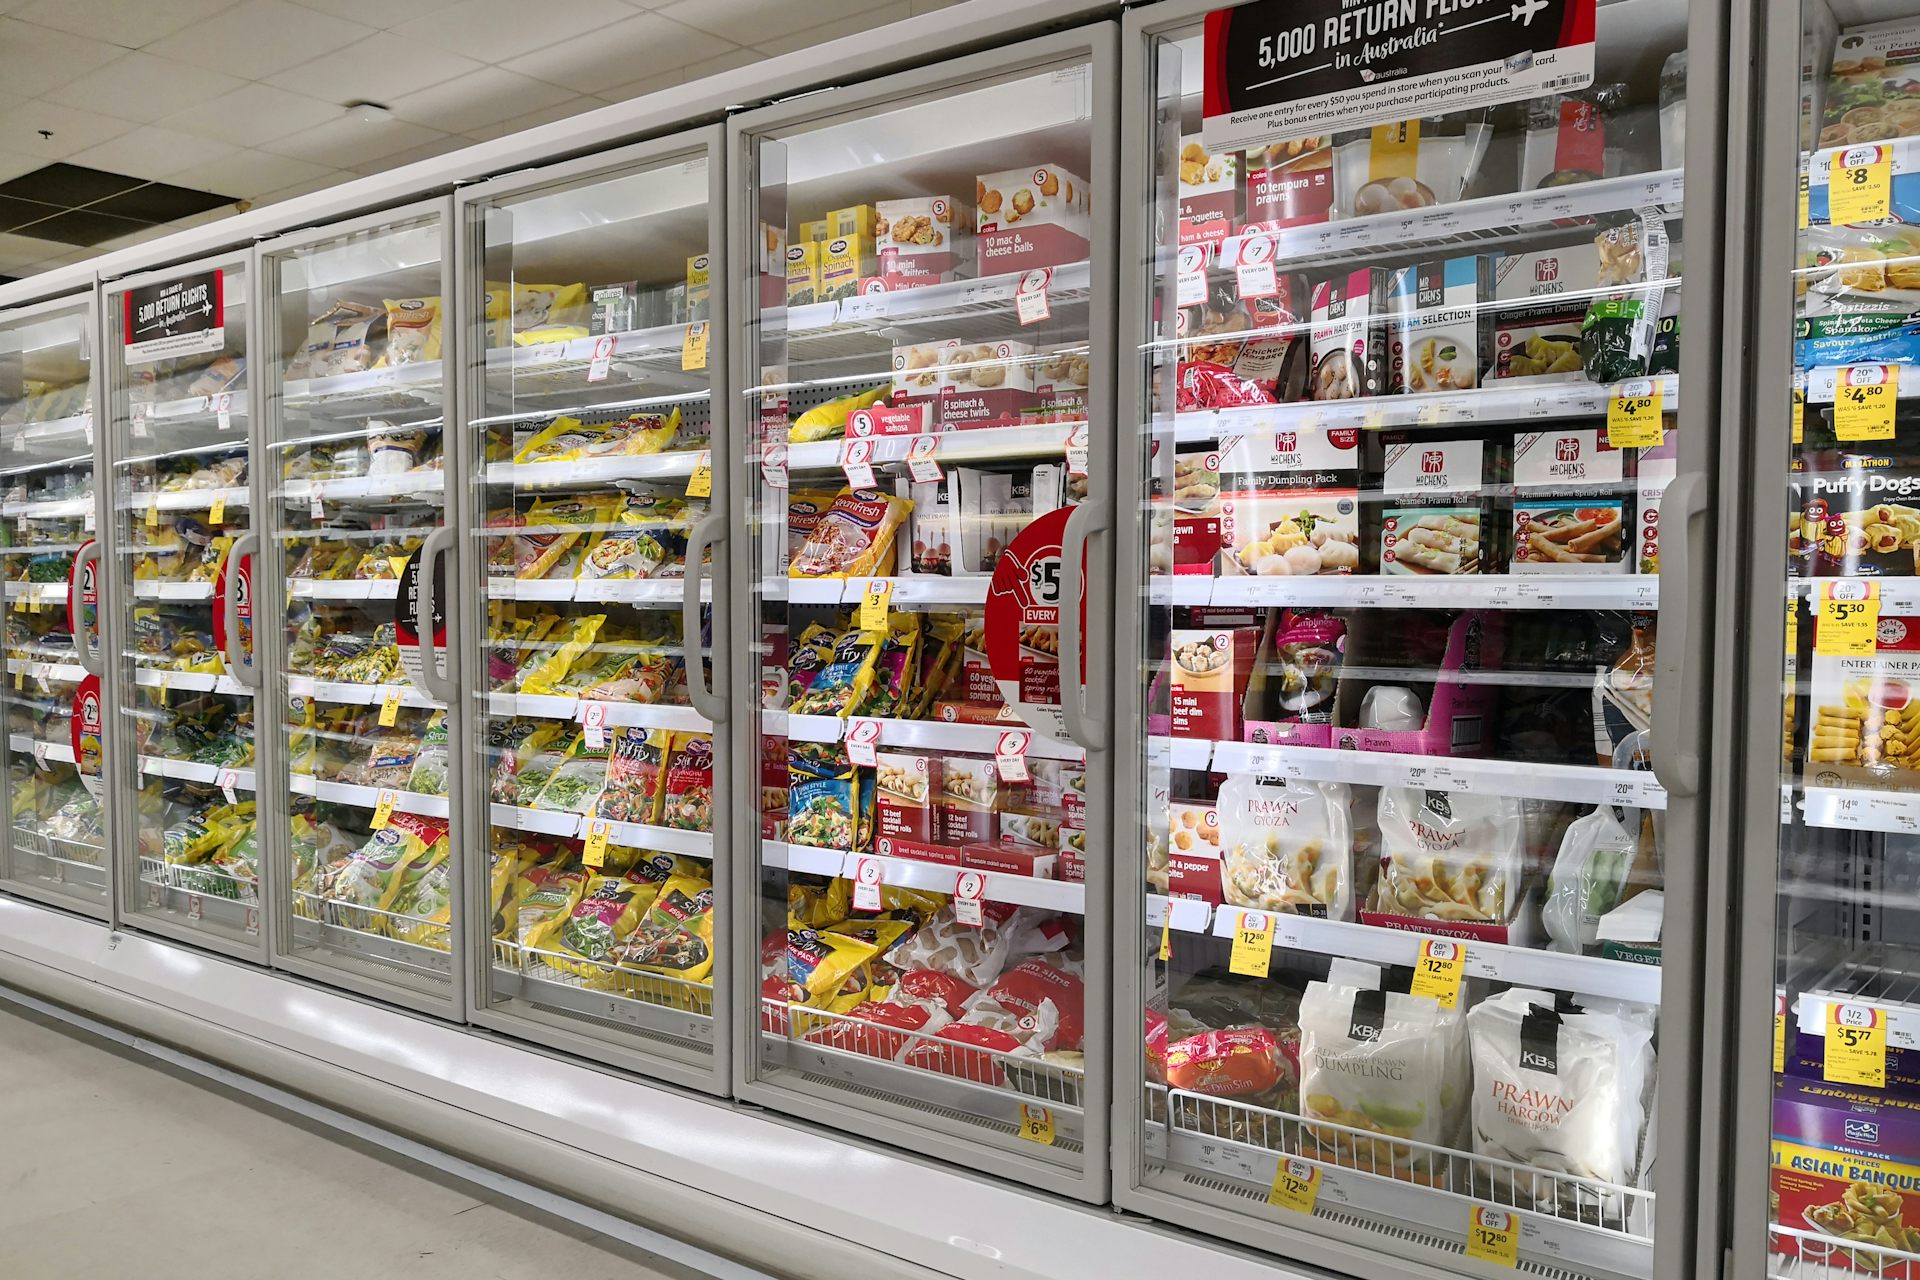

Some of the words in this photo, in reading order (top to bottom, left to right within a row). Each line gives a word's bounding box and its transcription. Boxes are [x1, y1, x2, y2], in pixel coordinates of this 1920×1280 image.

[1259, 24, 1316, 69] 5,000
[1324, 0, 1416, 49] RETURN
[1336, 52, 1350, 69] in
[1375, 67, 1408, 79] australia
[1230, 113, 1258, 125] Receive
[1259, 110, 1273, 120] one
[1274, 104, 1295, 118] entry
[1295, 103, 1306, 115] for
[1307, 98, 1329, 111] every
[1330, 95, 1345, 106] $50
[1346, 92, 1361, 104] you
[1361, 87, 1387, 102] spend
[1387, 83, 1397, 94] in
[1397, 81, 1418, 92] store
[1419, 75, 1443, 88] when
[1444, 74, 1460, 86] you
[1461, 70, 1481, 80] scan
[1482, 65, 1503, 78] your
[1535, 53, 1557, 66] card.
[1267, 117, 1283, 129] Plus
[1284, 112, 1307, 125] bonus
[1308, 108, 1335, 121] entries
[1336, 105, 1359, 117] when
[1359, 102, 1375, 114] you
[1375, 93, 1413, 108] purchase
[1414, 84, 1469, 104] participating
[1470, 77, 1510, 93] products.
[1849, 158, 1866, 166] OFF
[1845, 168, 1868, 185] $8
[1256, 183, 1266, 197] 10
[1267, 178, 1309, 196] tempura
[1256, 191, 1290, 207] prawns
[986, 237, 994, 248] 10
[996, 236, 1013, 247] mac
[1014, 234, 1022, 243] &
[986, 245, 1012, 257] cheese
[1014, 242, 1033, 253] balls
[1251, 245, 1262, 257] $7
[827, 252, 850, 263] Chopped
[1184, 255, 1194, 267] $7
[823, 257, 855, 273] Spinach
[898, 259, 916, 269] mini
[1242, 267, 1257, 276] EVERY
[1257, 266, 1269, 274] DAY
[1419, 276, 1430, 289] MR
[155, 294, 180, 316] RETURN
[181, 283, 207, 308] FLIGHTS
[1020, 295, 1032, 303] EVERY
[1418, 287, 1442, 302] CHEN'S
[1329, 302, 1345, 316] CHEN'S
[1830, 300, 1891, 313] Pastizzis
[1391, 316, 1421, 331] STEAM
[1422, 309, 1472, 325] SELECTION
[1656, 318, 1673, 334] 10
[1313, 327, 1333, 341] PRAWN
[1813, 338, 1856, 349] Savoury
[1246, 346, 1285, 356] Chicken
[1856, 367, 1874, 377] 20%
[1856, 376, 1872, 384] OFF
[943, 400, 949, 409] 8
[949, 398, 978, 411] spinach
[978, 398, 985, 407] &
[880, 413, 911, 425] vegetable
[943, 408, 968, 419] cheese
[969, 407, 990, 418] twirls
[885, 423, 909, 433] samosa
[1331, 429, 1355, 437] FAMILY
[1278, 453, 1302, 465] CHEN'S
[1558, 462, 1585, 475] CHEN'S
[1238, 475, 1266, 487] Family
[1268, 474, 1313, 487] Dumpling
[1315, 473, 1338, 484] Pack
[1813, 476, 1868, 495] Puffy
[1870, 475, 1920, 495] Dogs
[1012, 485, 1030, 495] KBs
[1521, 489, 1552, 499] Premium
[1552, 489, 1574, 499] Prawn
[1575, 488, 1599, 500] Spring
[1599, 487, 1613, 497] Roll
[1394, 495, 1427, 506] Steamed
[1427, 495, 1451, 505] Prawn
[1452, 494, 1468, 505] Roll
[1031, 561, 1060, 601] $5
[870, 594, 880, 605] $3
[1026, 609, 1056, 621] EVERY
[970, 673, 980, 682] 60
[969, 683, 995, 693] cocktail
[1173, 696, 1181, 706] 15
[1182, 696, 1197, 706] mini
[1173, 706, 1187, 716] beef
[1188, 706, 1203, 717] dim
[1173, 717, 1188, 726] sims
[1364, 737, 1391, 747] Prawn
[674, 754, 691, 768] Stir
[694, 755, 713, 770] Fry
[1248, 799, 1298, 814] PRAWN
[883, 816, 902, 824] cocktail
[889, 810, 902, 818] beef
[1253, 814, 1290, 827] GYOZA
[883, 823, 899, 833] spring
[900, 824, 912, 833] rolls
[1416, 838, 1460, 851] GYOZA
[928, 851, 944, 861] spring
[945, 852, 957, 861] rolls
[1384, 920, 1433, 936] PRAWN
[1436, 928, 1481, 942] GYOZA
[1433, 942, 1448, 950] 20%
[1433, 949, 1446, 957] OFF
[1847, 1009, 1862, 1020] 1/2
[1845, 1018, 1863, 1026] Price
[1315, 1054, 1402, 1081] DUMPLING
[1233, 1079, 1254, 1089] Sim
[1491, 1079, 1575, 1113] PRAWN
[1496, 1101, 1562, 1125] HARGOW
[1506, 1116, 1551, 1132] DUMPLINGS
[1833, 1145, 1865, 1156] FAMILY
[1867, 1151, 1891, 1161] PACK
[1791, 1155, 1845, 1178] ASIAN
[1292, 1169, 1303, 1177] OFF
[1485, 1218, 1499, 1228] OFF
